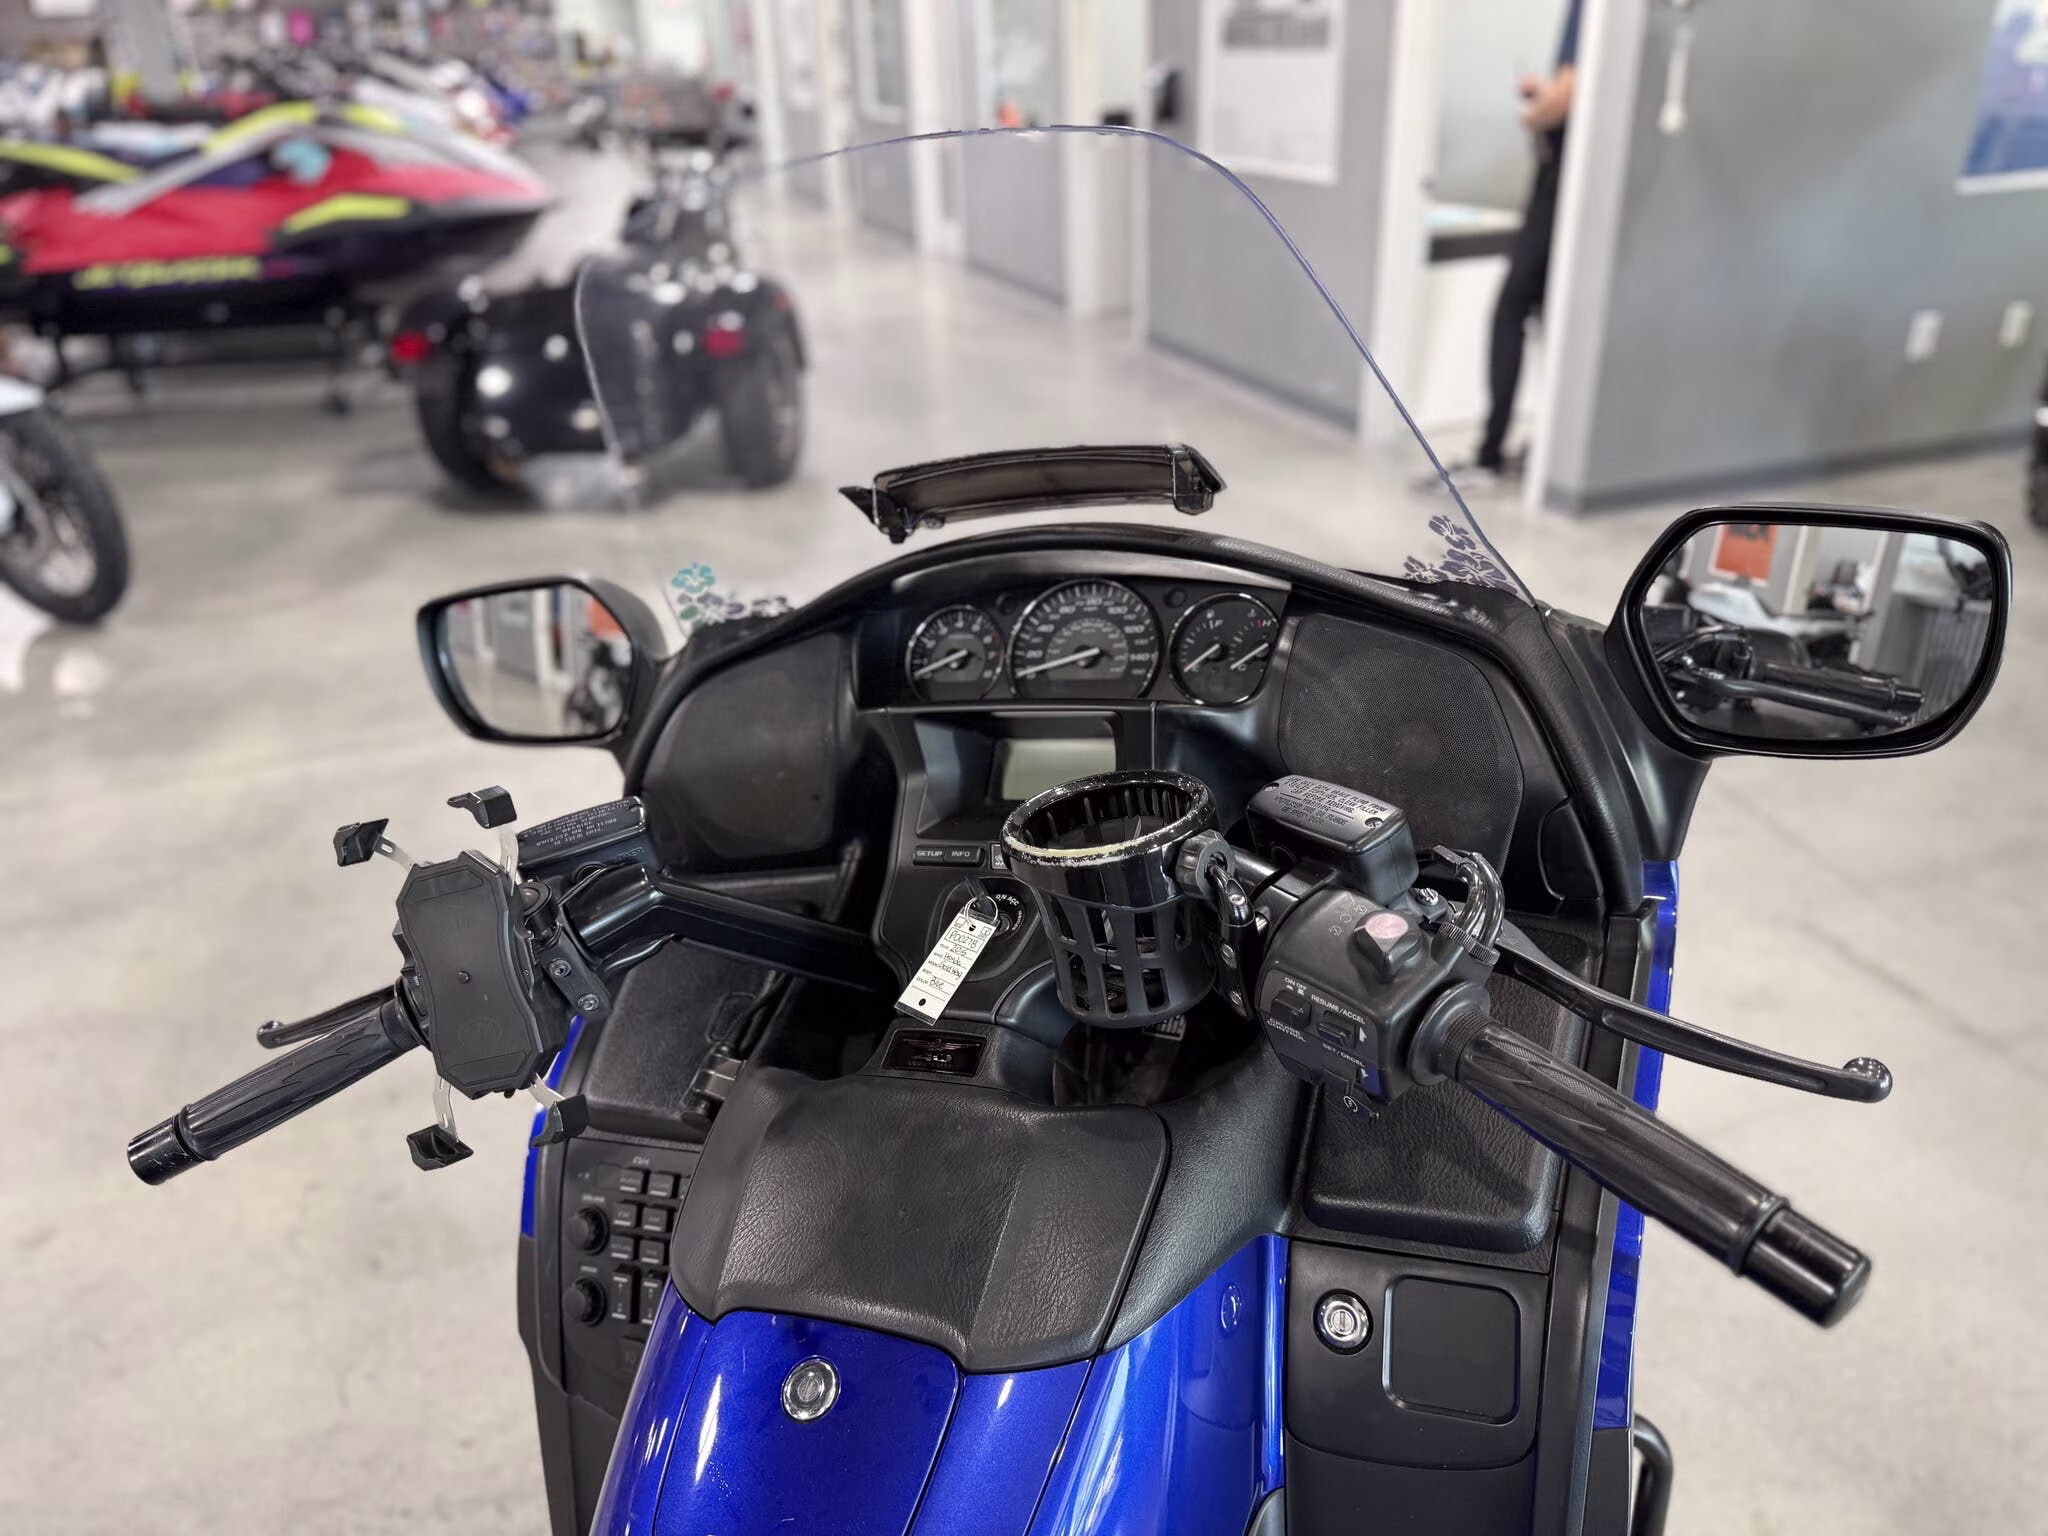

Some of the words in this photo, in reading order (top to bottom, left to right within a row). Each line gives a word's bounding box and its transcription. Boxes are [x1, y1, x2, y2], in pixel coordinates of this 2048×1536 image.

[916, 850, 943, 858] SETUP
[951, 850, 971, 858] INFO
[1284, 977, 1296, 987] ON
[1311, 993, 1366, 1025] RESUME/ACCEL
[1322, 1042, 1365, 1068] SET/DECEL
